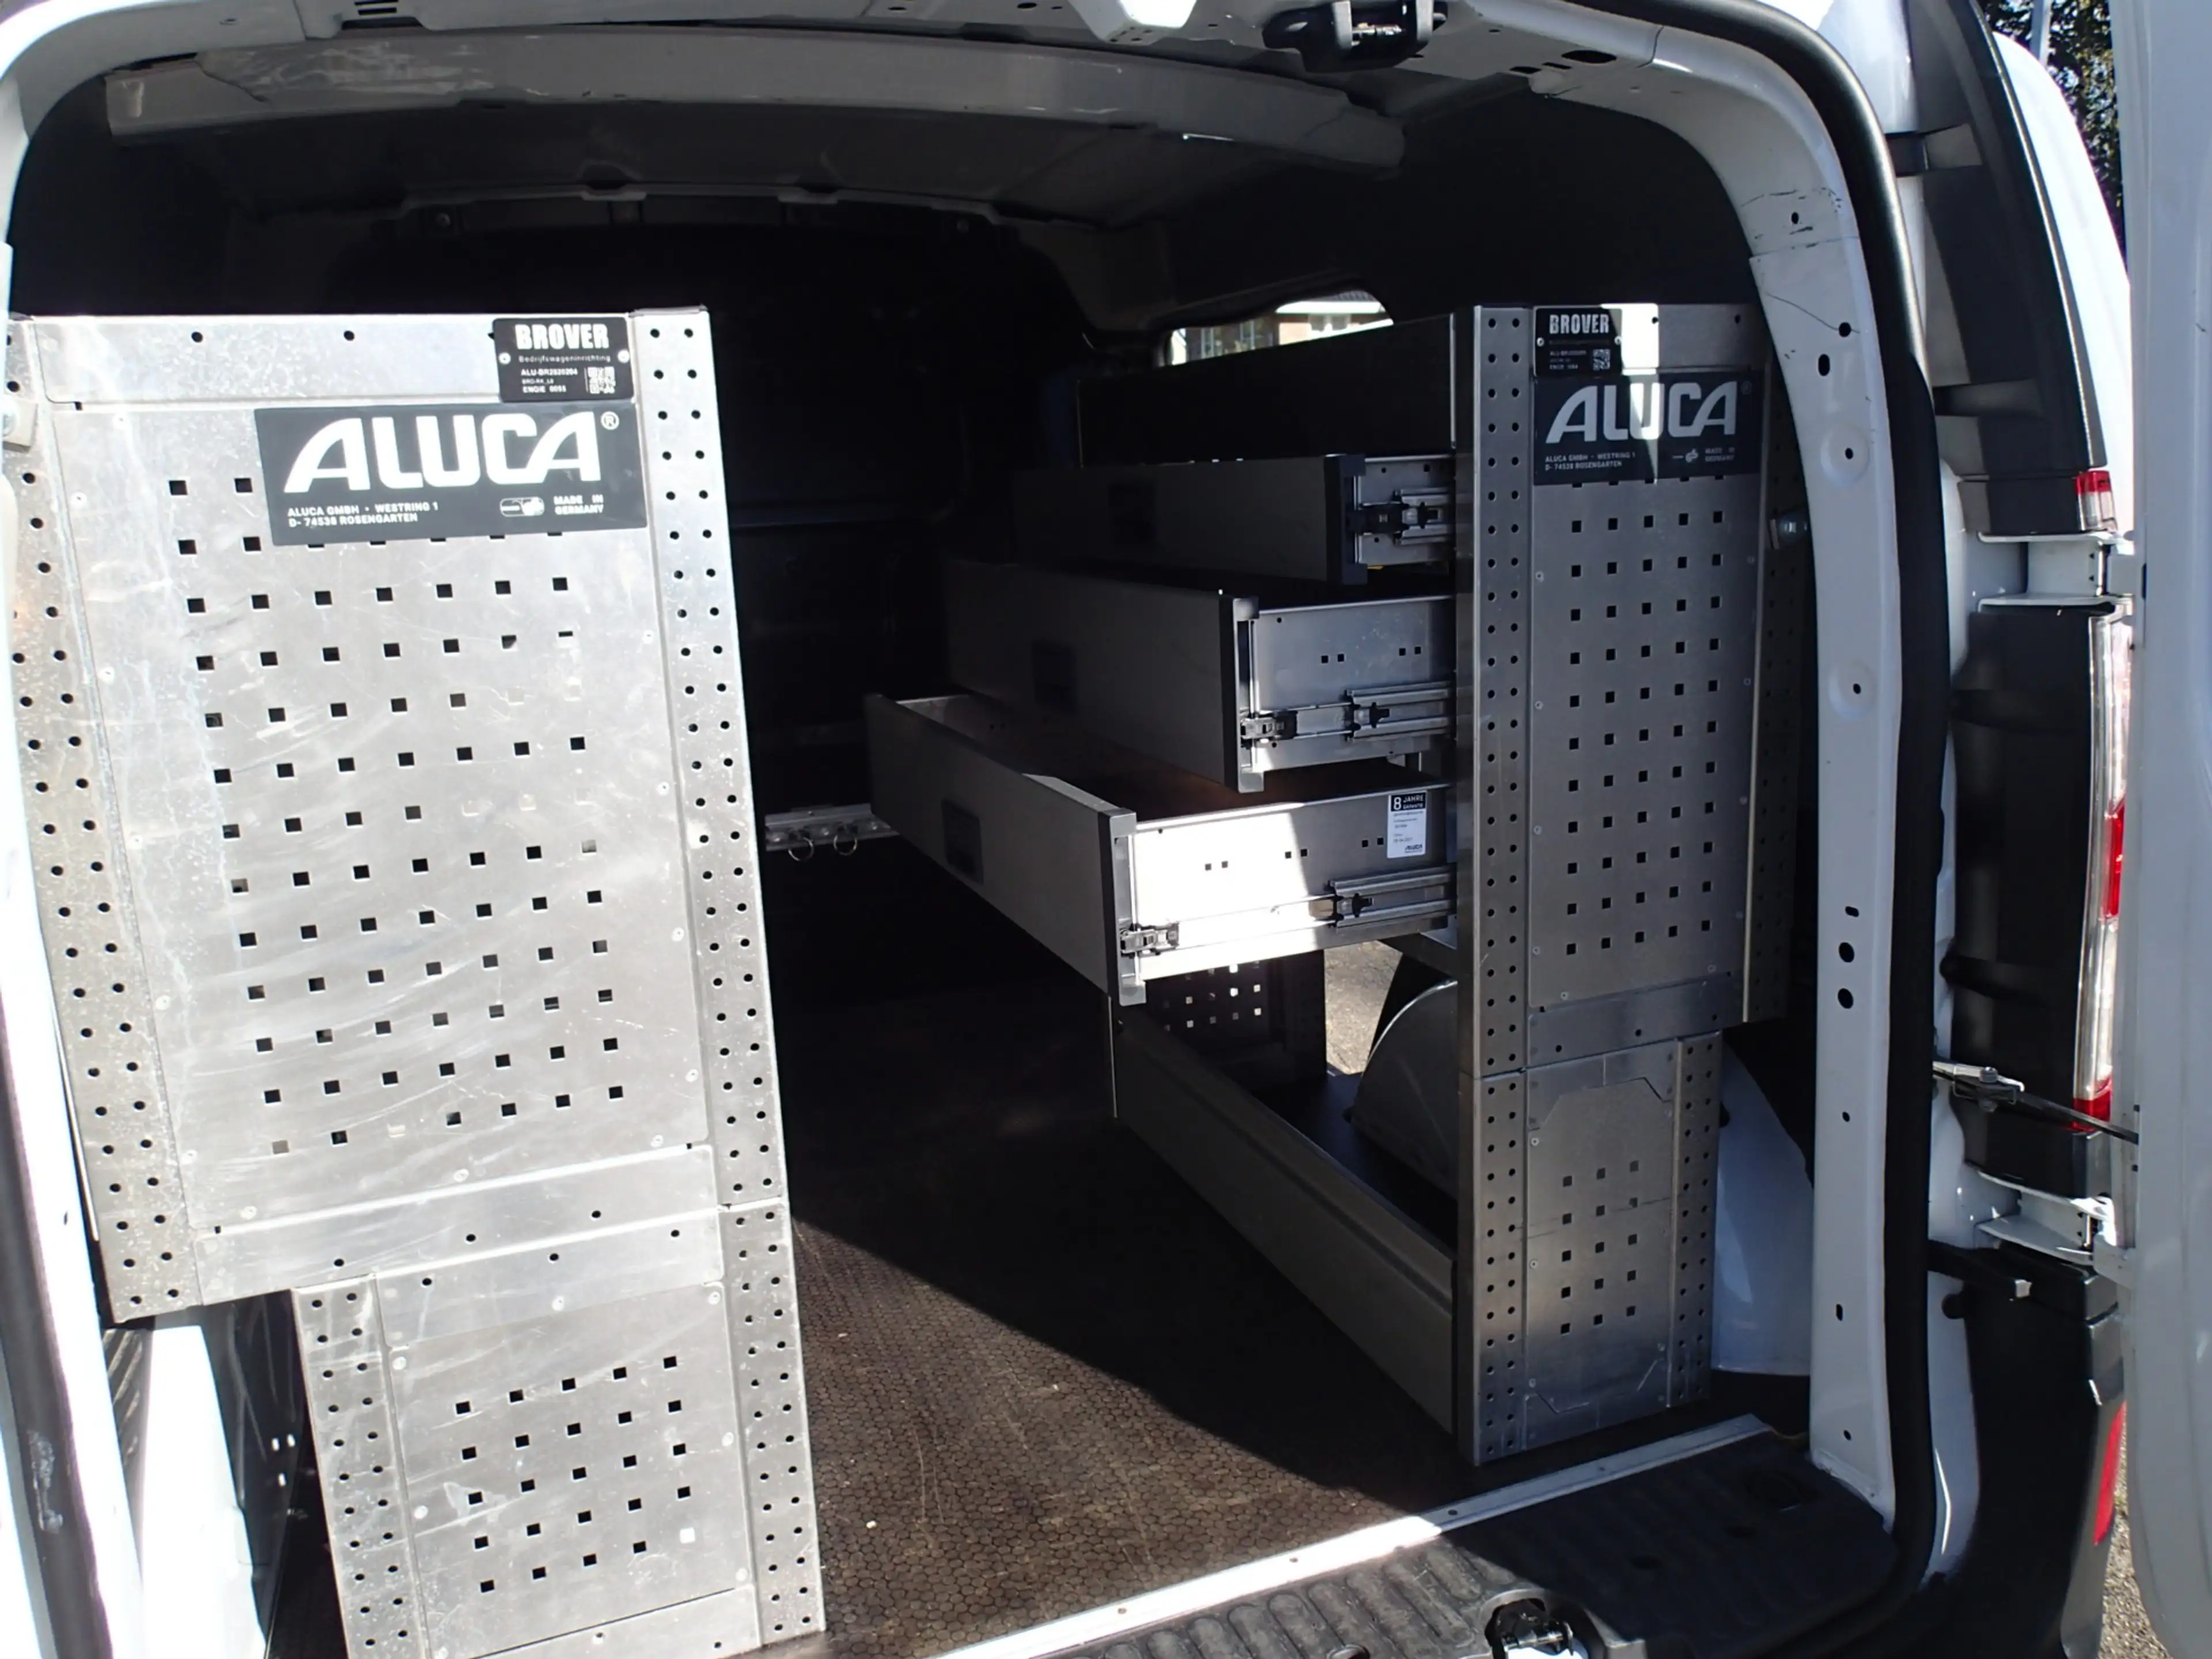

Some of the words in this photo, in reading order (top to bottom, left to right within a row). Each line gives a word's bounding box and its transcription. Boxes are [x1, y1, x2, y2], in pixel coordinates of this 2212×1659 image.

[1550, 314, 1609, 334] BROVER
[515, 323, 609, 349] BROVER
[1546, 381, 1737, 444] ALUCA
[1545, 454, 1567, 463] ALUCA
[554, 495, 583, 505] MADE
[592, 494, 604, 503] IN
[287, 506, 324, 517] ALUCA
[326, 505, 359, 516] GMBH
[374, 501, 430, 513] WESTRING
[432, 502, 438, 511] 1
[555, 504, 604, 515] GERMANY
[339, 512, 418, 525] ROSENGARTEN
[1393, 797, 1402, 810] 8
